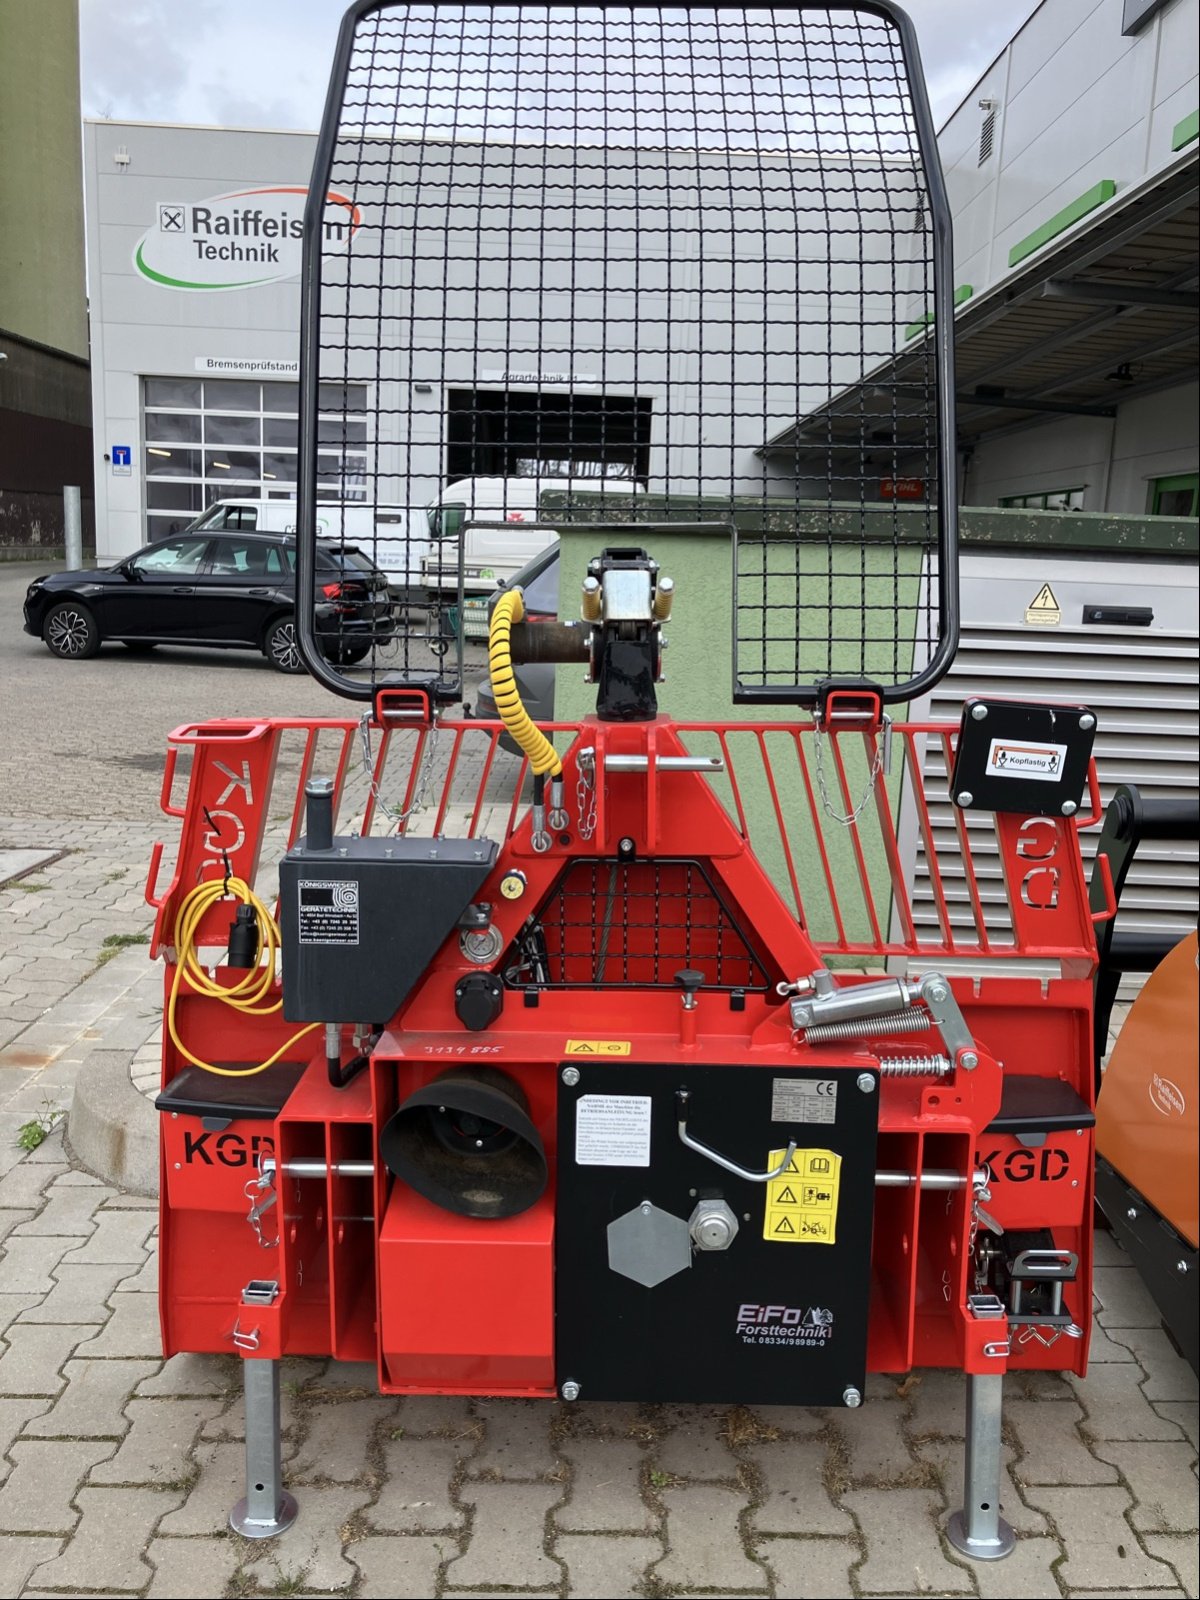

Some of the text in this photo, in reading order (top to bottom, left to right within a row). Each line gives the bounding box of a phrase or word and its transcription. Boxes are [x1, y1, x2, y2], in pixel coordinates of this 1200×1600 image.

[192, 207, 343, 240] Raiffeisn
[193, 239, 279, 263] Technik
[207, 359, 298, 371] Bremsenprüfstand
[1010, 757, 1046, 767] Kopflastig
[974, 1148, 1070, 1183] KGD
[736, 1322, 828, 1338] Forsttechnik
[742, 1336, 756, 1344] Tel.
